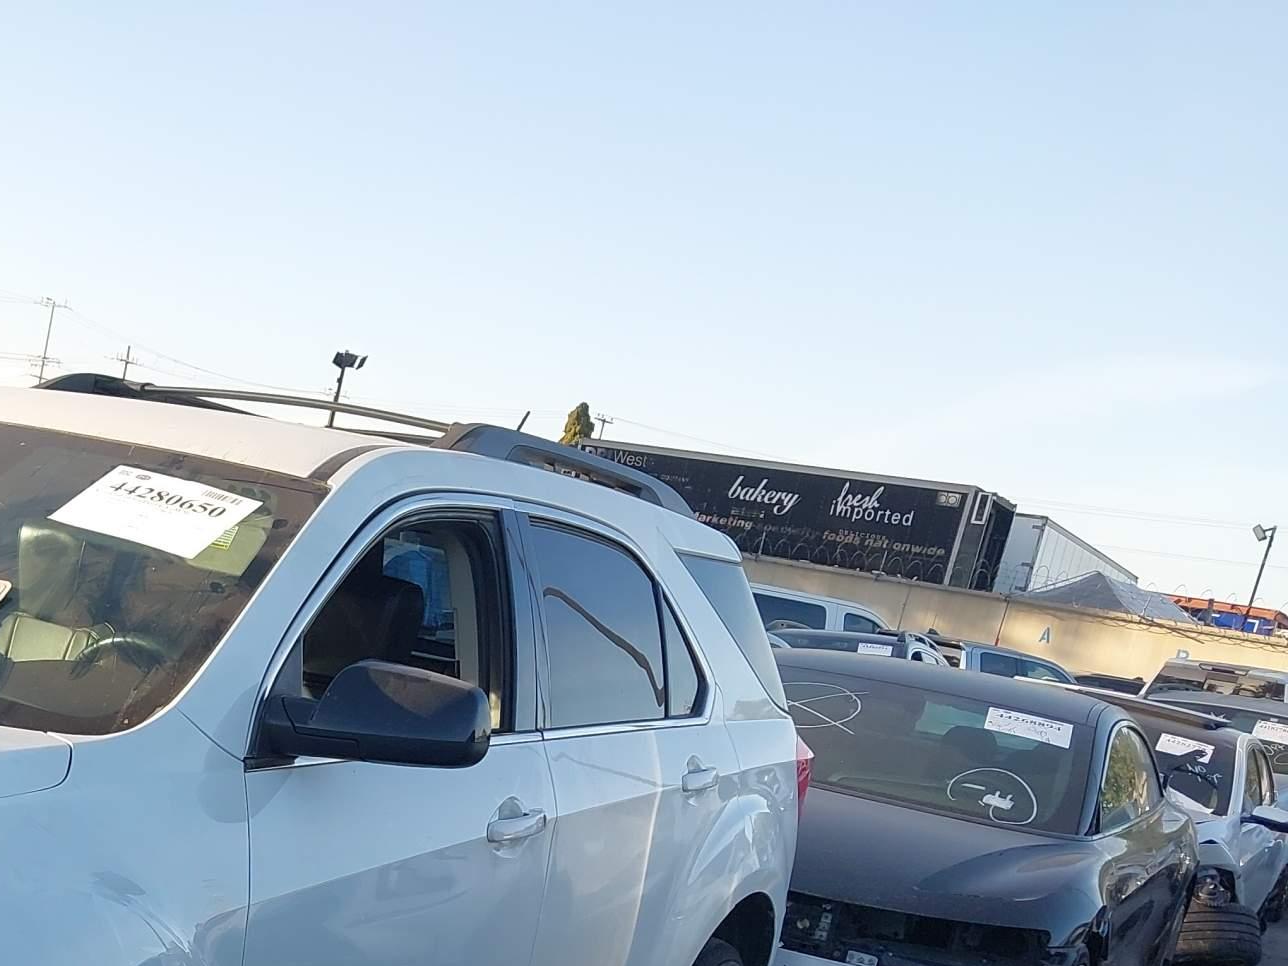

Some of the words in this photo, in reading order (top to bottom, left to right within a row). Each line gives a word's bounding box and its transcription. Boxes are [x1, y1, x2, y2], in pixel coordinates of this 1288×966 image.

[614, 451, 648, 467] West
[109, 481, 227, 518] 44280650
[728, 475, 800, 515] bakery
[835, 480, 884, 511] fresh
[829, 499, 914, 526] imported
[1039, 627, 1051, 644] A
